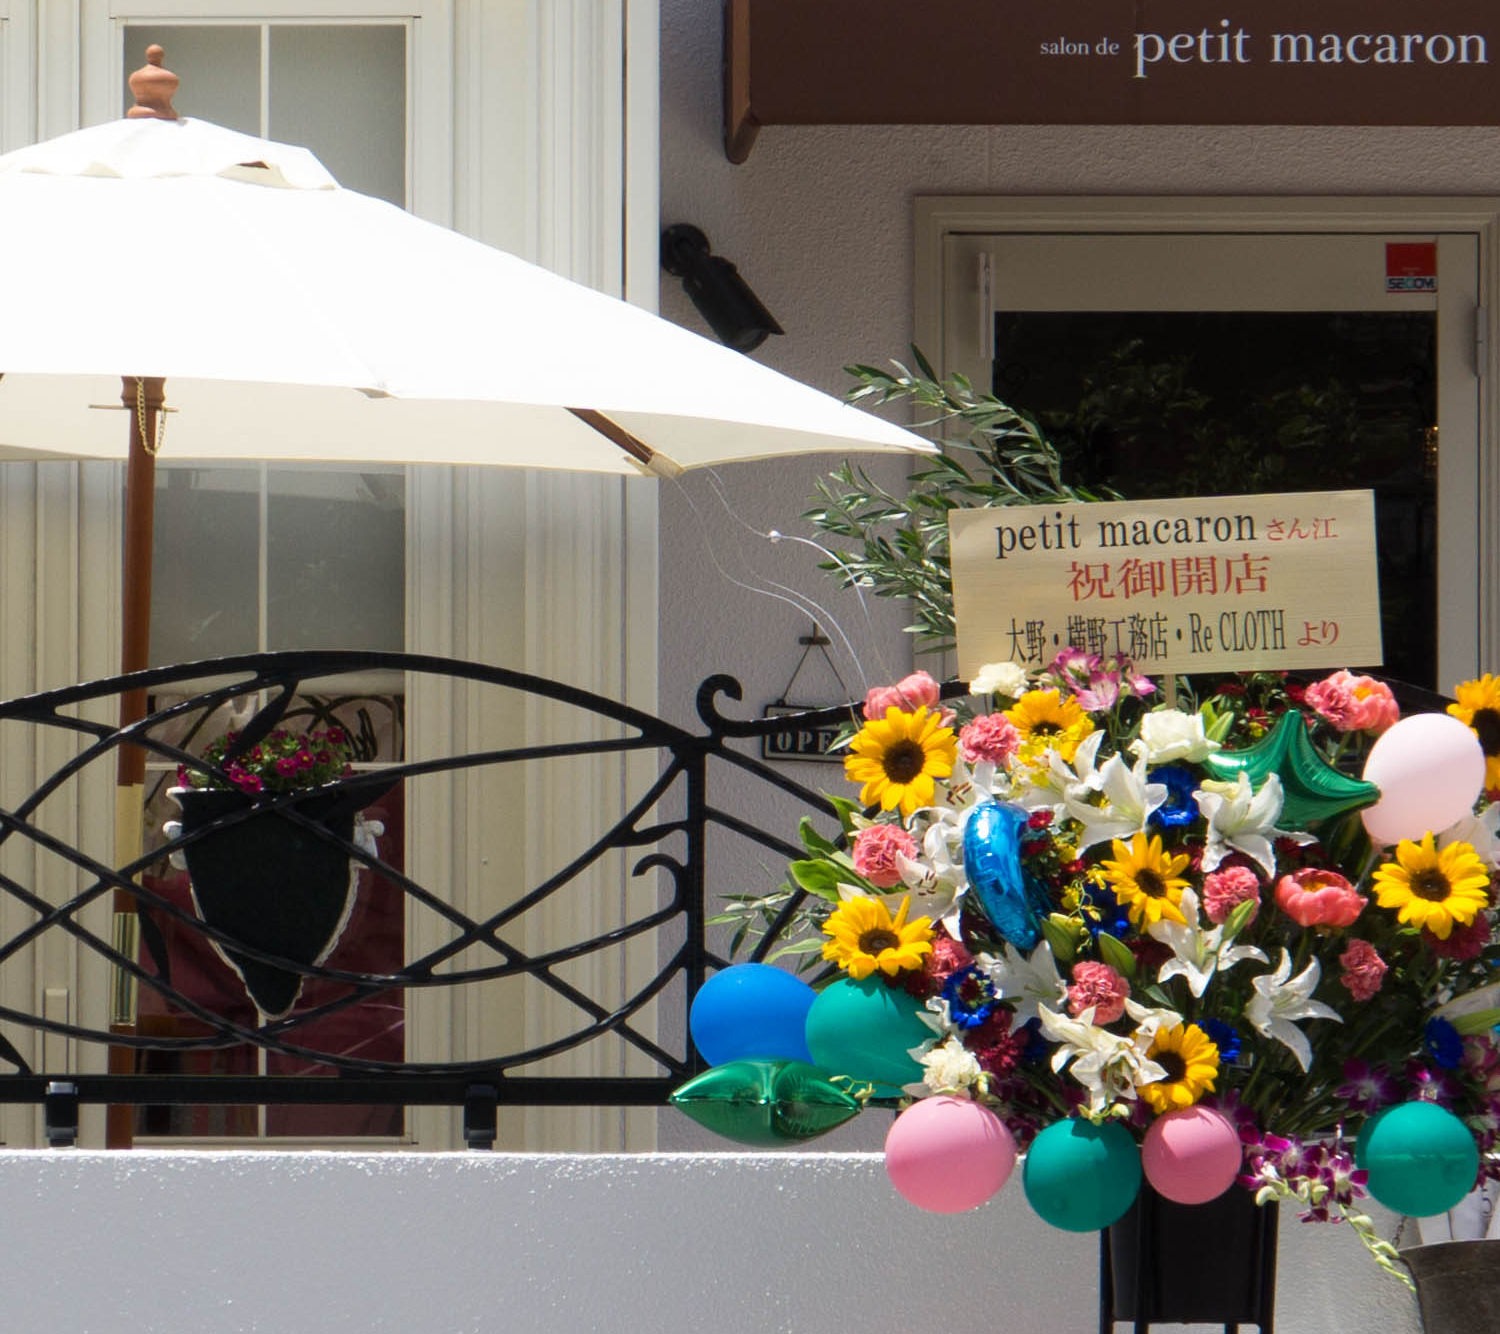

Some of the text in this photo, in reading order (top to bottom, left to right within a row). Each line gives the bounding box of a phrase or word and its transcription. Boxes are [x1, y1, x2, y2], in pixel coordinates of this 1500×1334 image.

[1040, 18, 1489, 78] salon de petit macaron
[995, 511, 1339, 560] petit macaron さん江
[1065, 553, 1271, 602] 祝御開店
[1219, 609, 1287, 652] CLOTH
[1297, 620, 1339, 647] より
[776, 729, 853, 754] OPE
